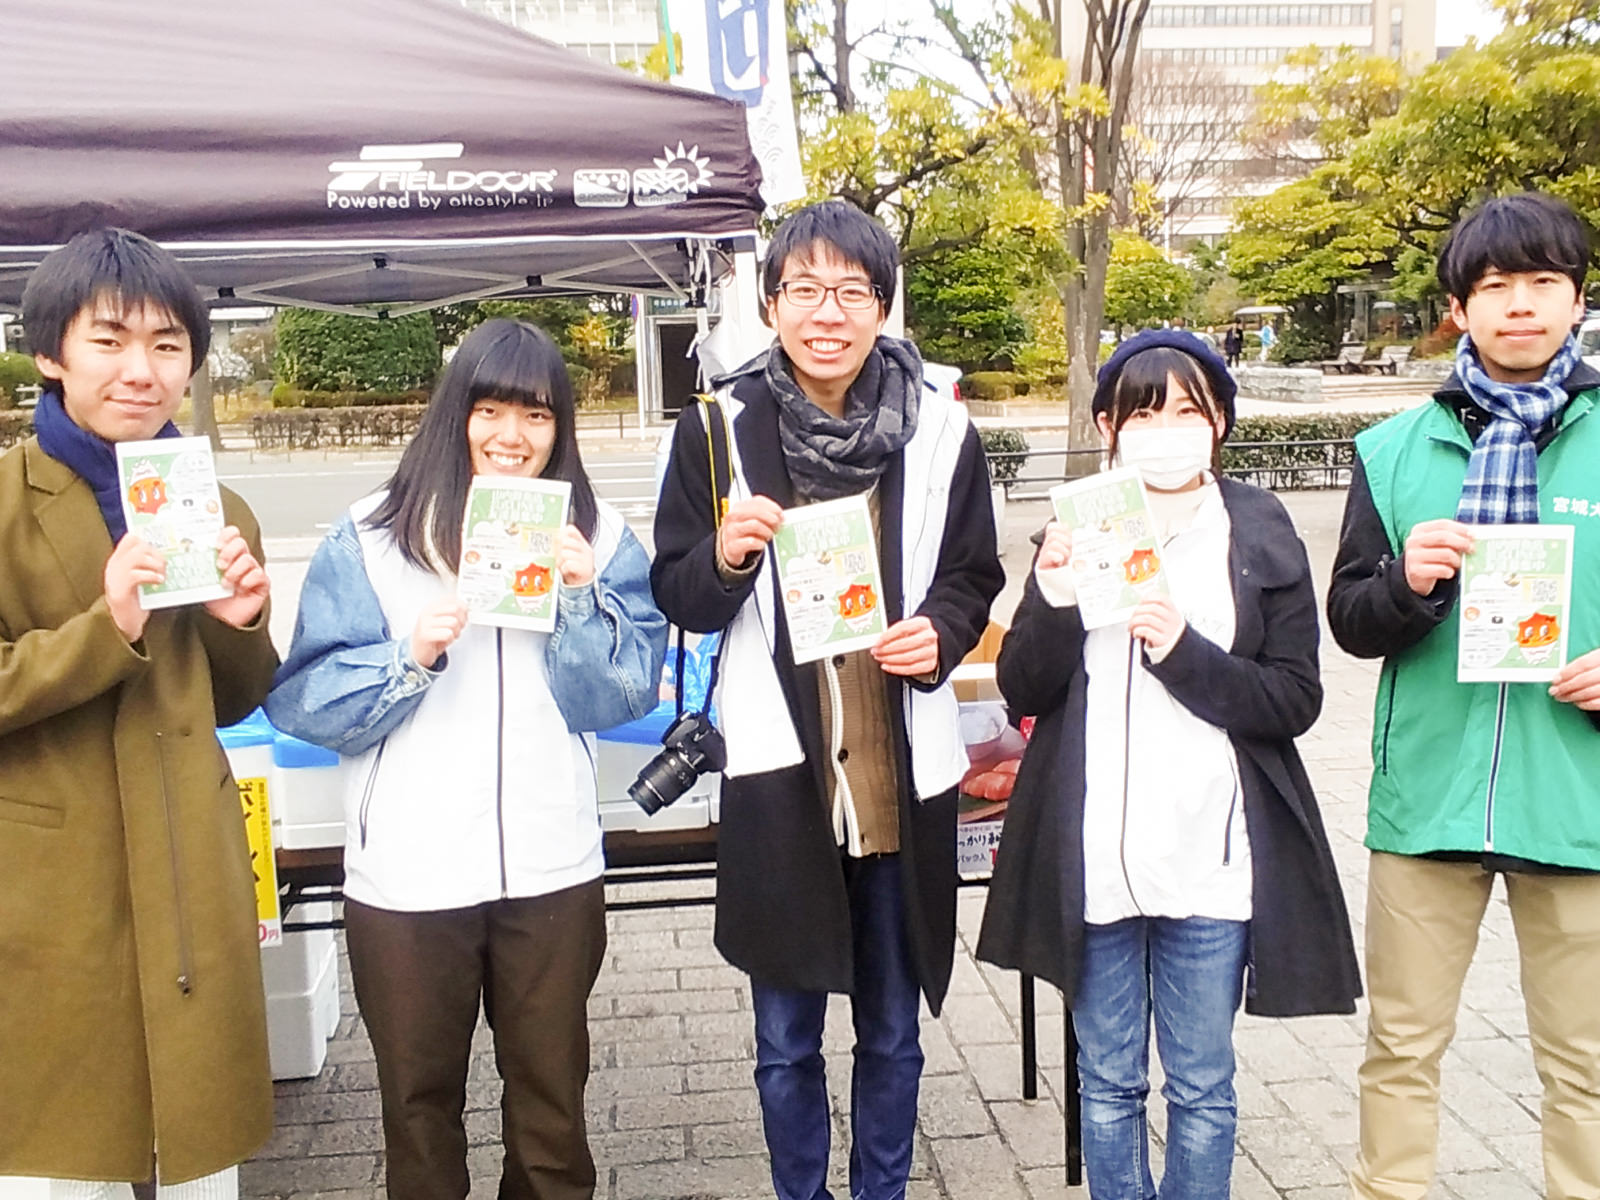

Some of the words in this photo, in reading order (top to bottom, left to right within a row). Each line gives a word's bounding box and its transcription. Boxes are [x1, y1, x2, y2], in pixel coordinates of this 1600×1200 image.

[379, 169, 557, 192] FIELDOOR
[327, 190, 410, 209] Powered
[418, 189, 441, 210] by
